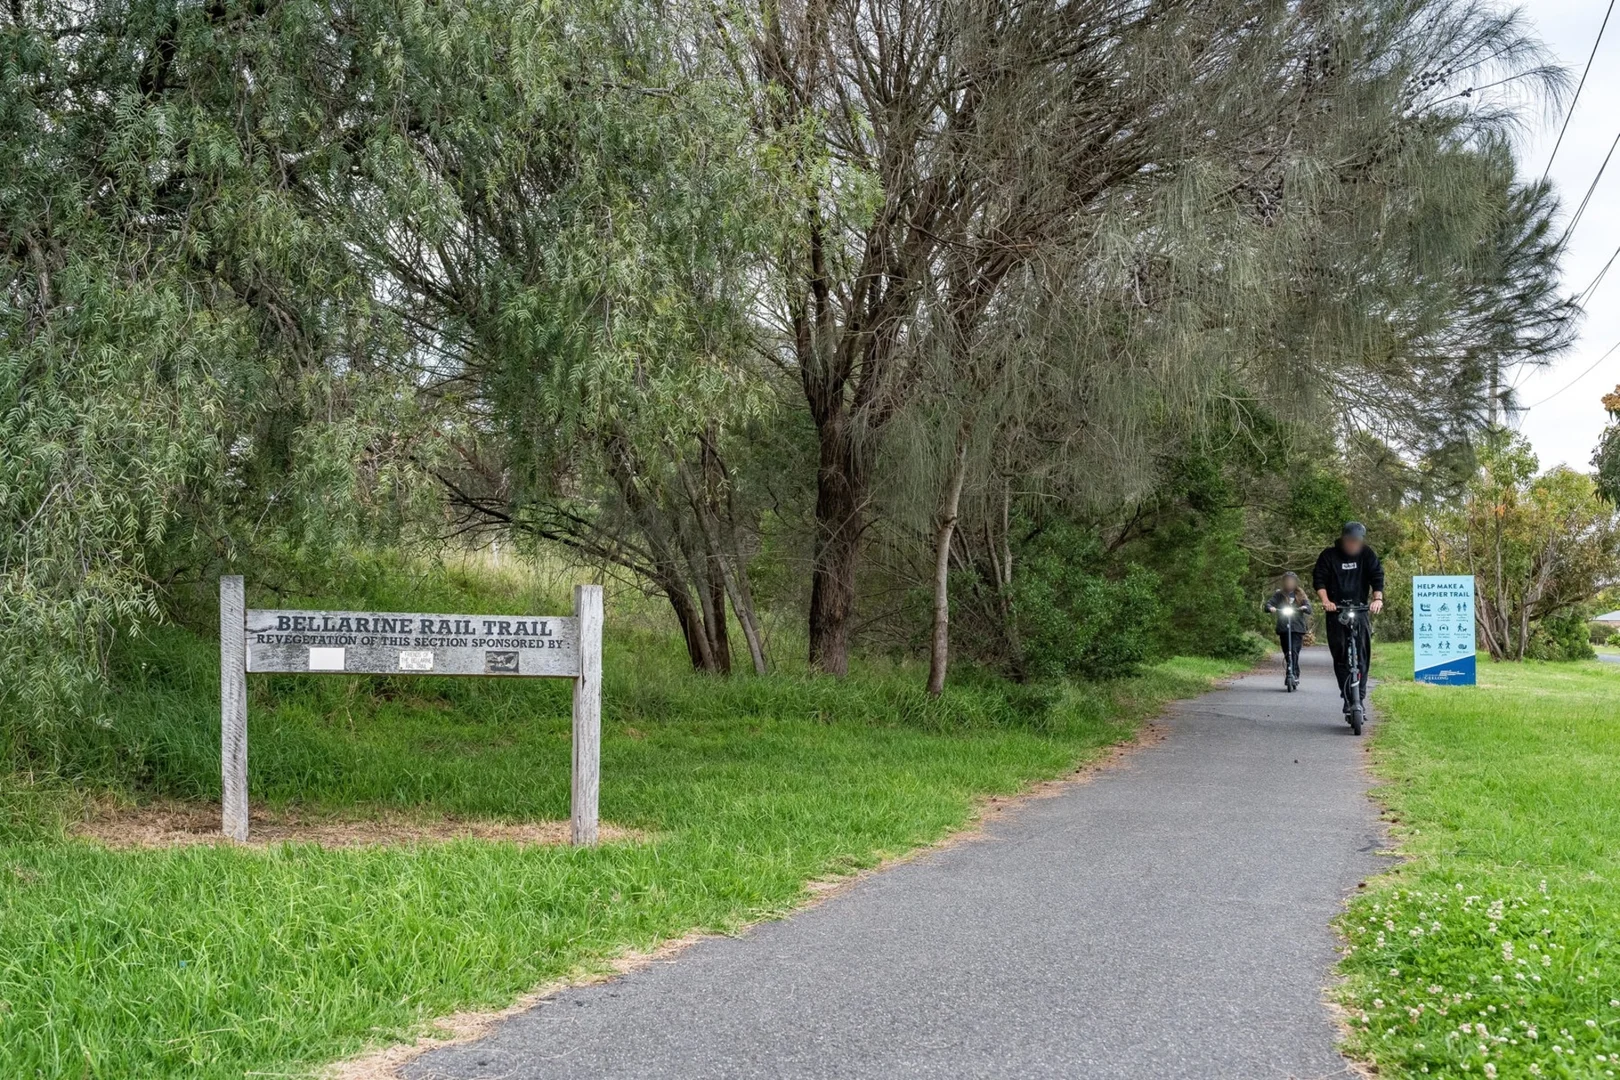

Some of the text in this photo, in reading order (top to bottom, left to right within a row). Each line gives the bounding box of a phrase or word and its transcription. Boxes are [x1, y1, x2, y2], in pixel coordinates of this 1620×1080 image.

[276, 615, 552, 636] BELLARINE RAIL TRAIL
[256, 634, 358, 646] REVEGETATION
[360, 636, 378, 646] OF
[380, 636, 410, 646] THIS
[414, 637, 468, 647] SECTION
[471, 638, 545, 649] SPONSORED
